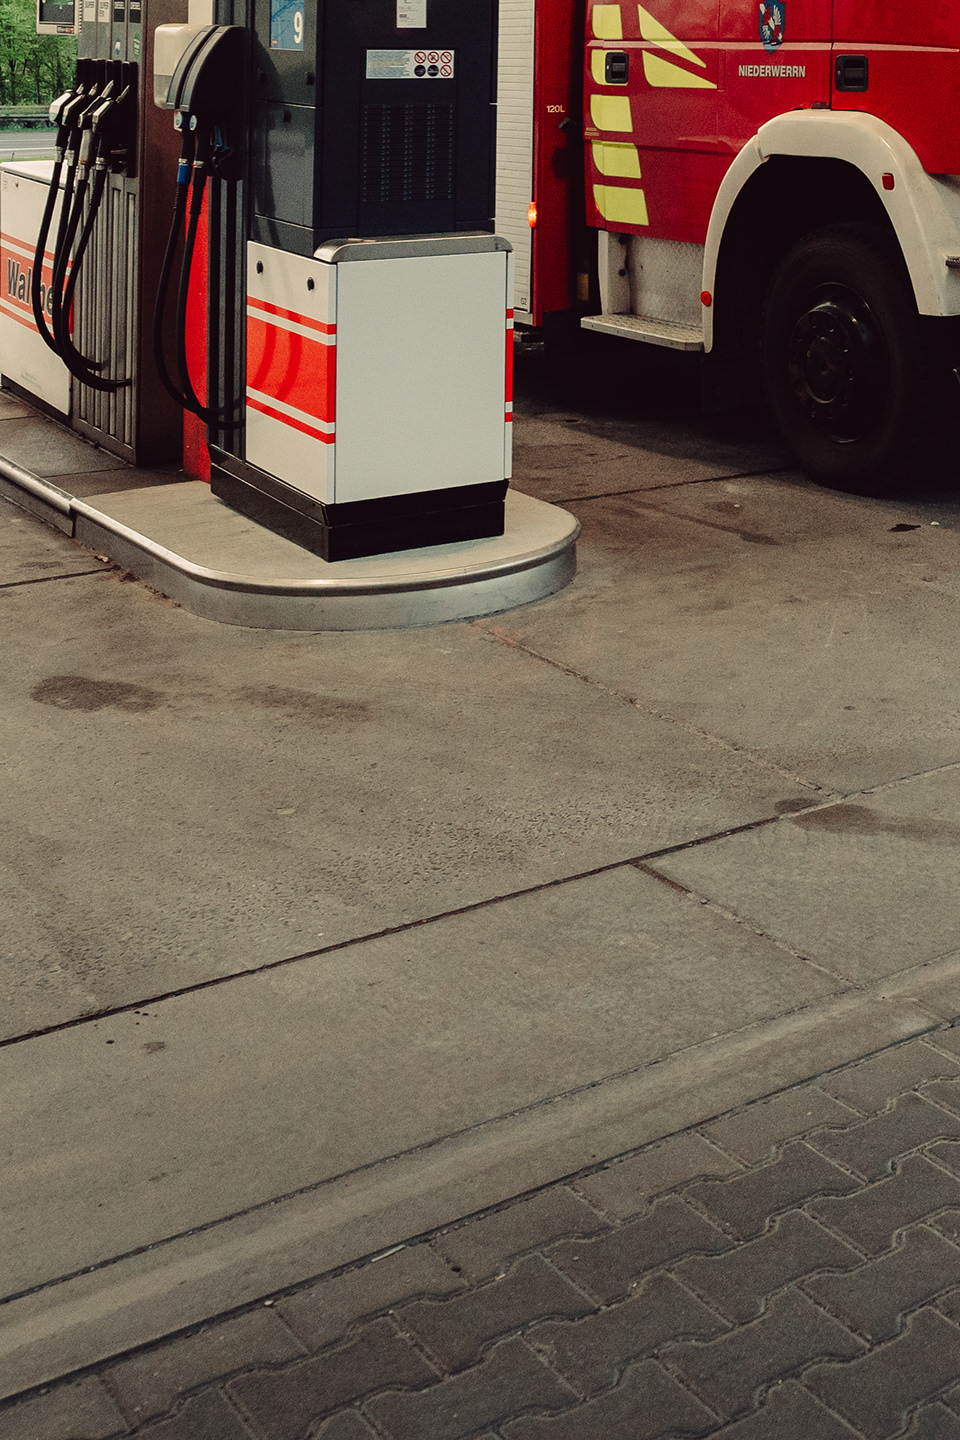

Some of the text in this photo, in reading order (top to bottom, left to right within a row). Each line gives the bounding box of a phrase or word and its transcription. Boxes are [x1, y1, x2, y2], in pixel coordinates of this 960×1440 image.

[293, 11, 303, 44] 9
[738, 65, 806, 77] NIEDERWERRN
[546, 105, 565, 113] 120L
